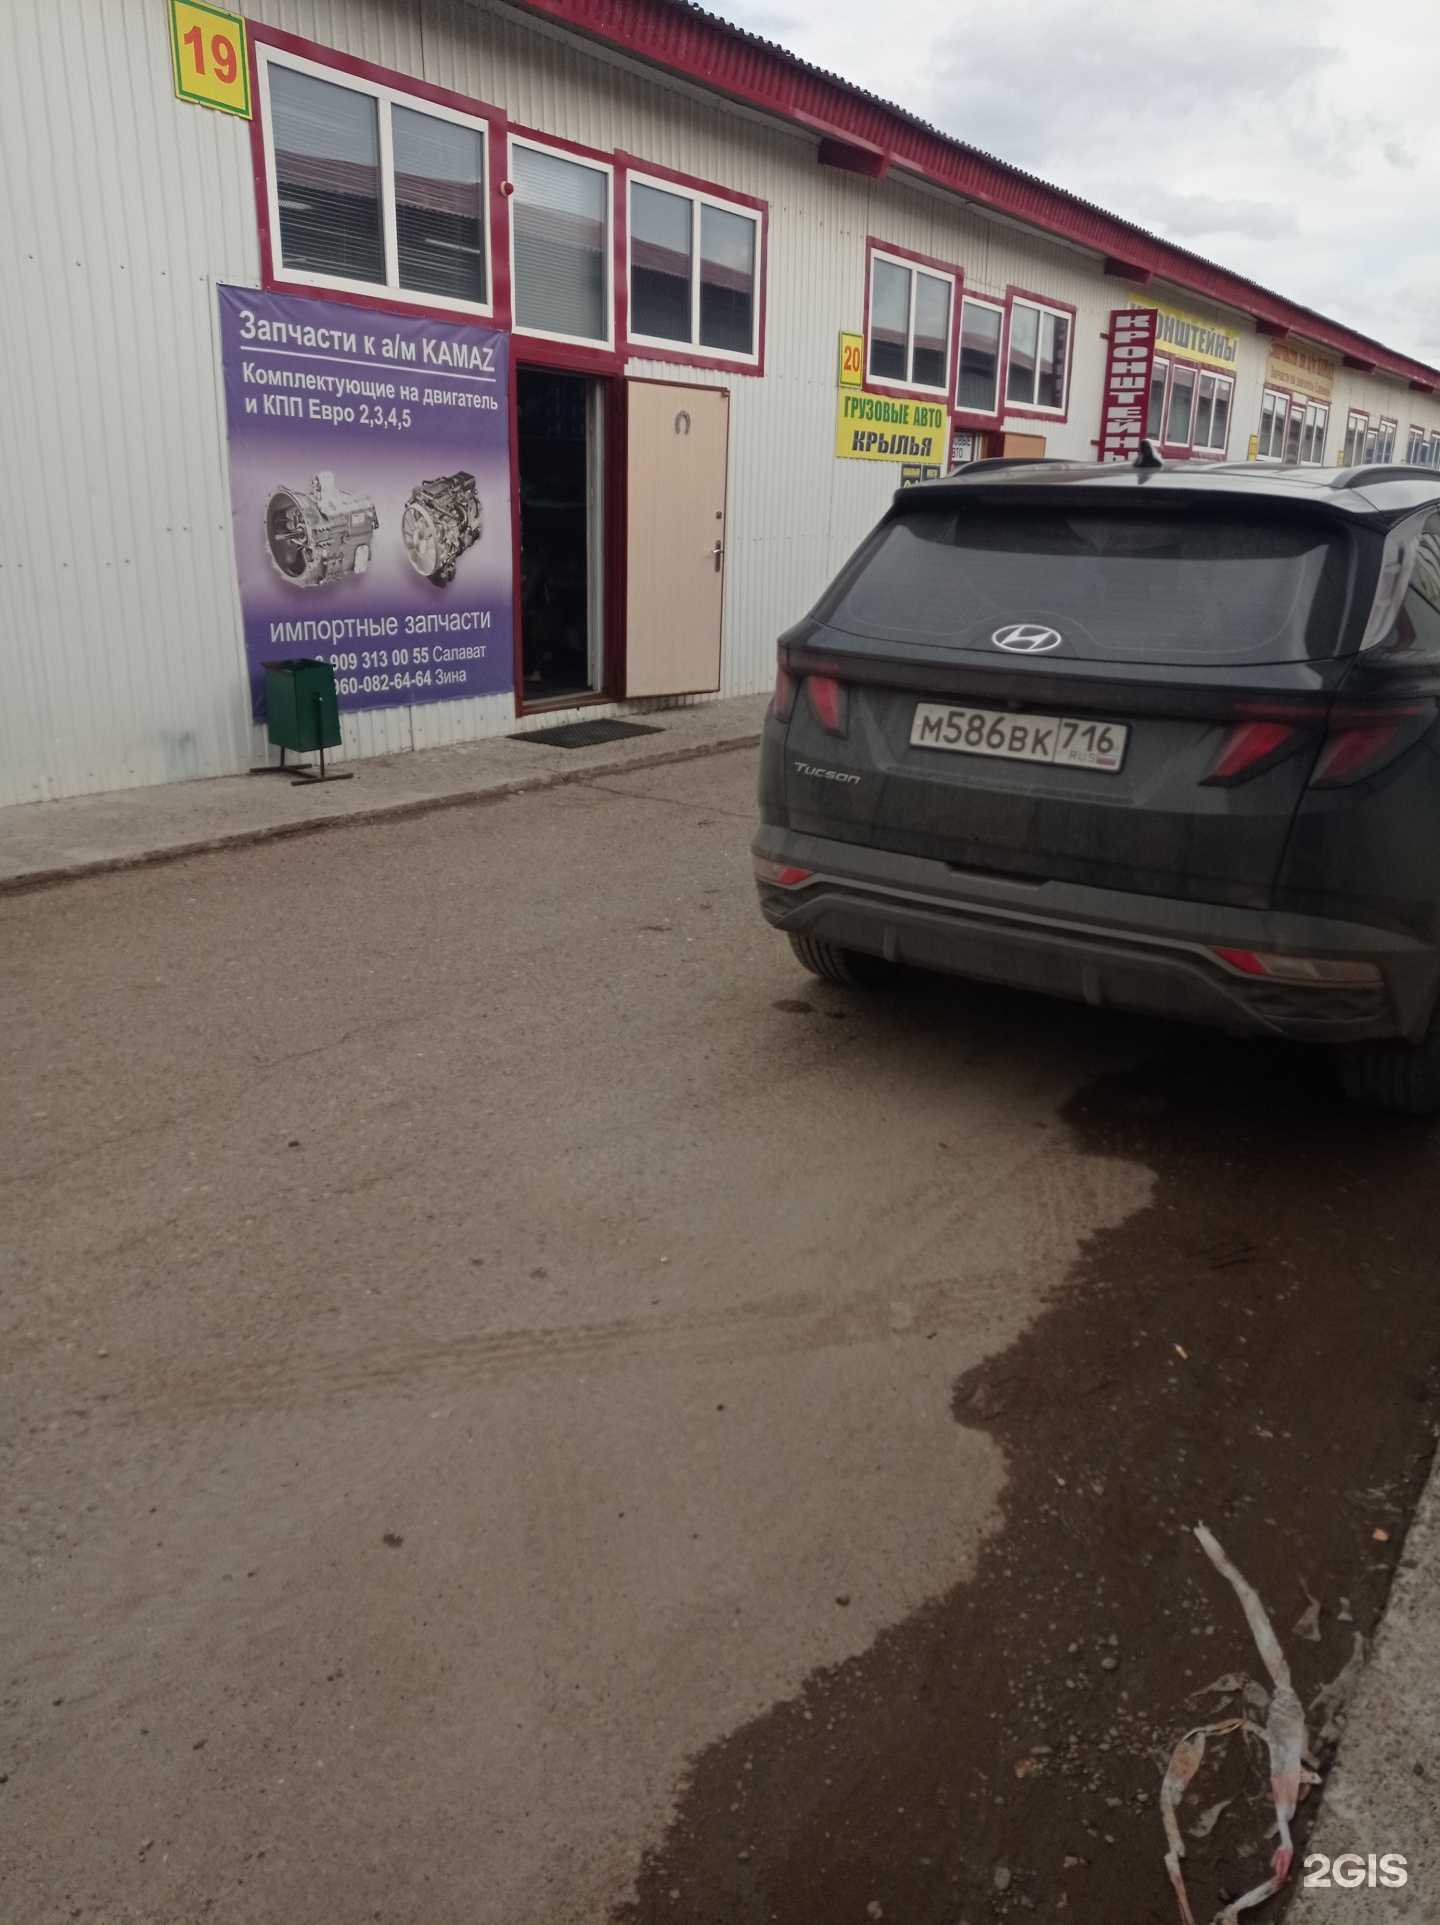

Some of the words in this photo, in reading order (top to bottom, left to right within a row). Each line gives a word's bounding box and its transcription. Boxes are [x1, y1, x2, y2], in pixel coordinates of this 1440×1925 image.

[184, 25, 237, 84] 19
[239, 310, 357, 353] Запчасти
[363, 335, 377, 356] к
[381, 333, 416, 361] а/м
[843, 346, 860, 372] 20
[242, 361, 396, 400] Комплектующие
[400, 385, 419, 402] на
[422, 388, 499, 410] двигатель
[245, 397, 258, 415] и
[263, 394, 304, 418] КПП
[308, 398, 355, 426] Евро
[359, 403, 412, 430] 2,3,4,5
[843, 395, 910, 425] ГРУЗОВЫЕ
[912, 406, 943, 429] АВТО
[851, 429, 933, 457] КРЫЛЬЯ
[270, 616, 399, 646] импортные
[404, 611, 492, 635] запчасти
[361, 649, 388, 669] 313
[391, 648, 409, 667] 00
[412, 646, 430, 665] 55
[432, 645, 487, 663] Салават
[434, 668, 468, 686] Зина
[1068, 751, 1096, 763] RUS
[794, 761, 861, 785] Tucson
